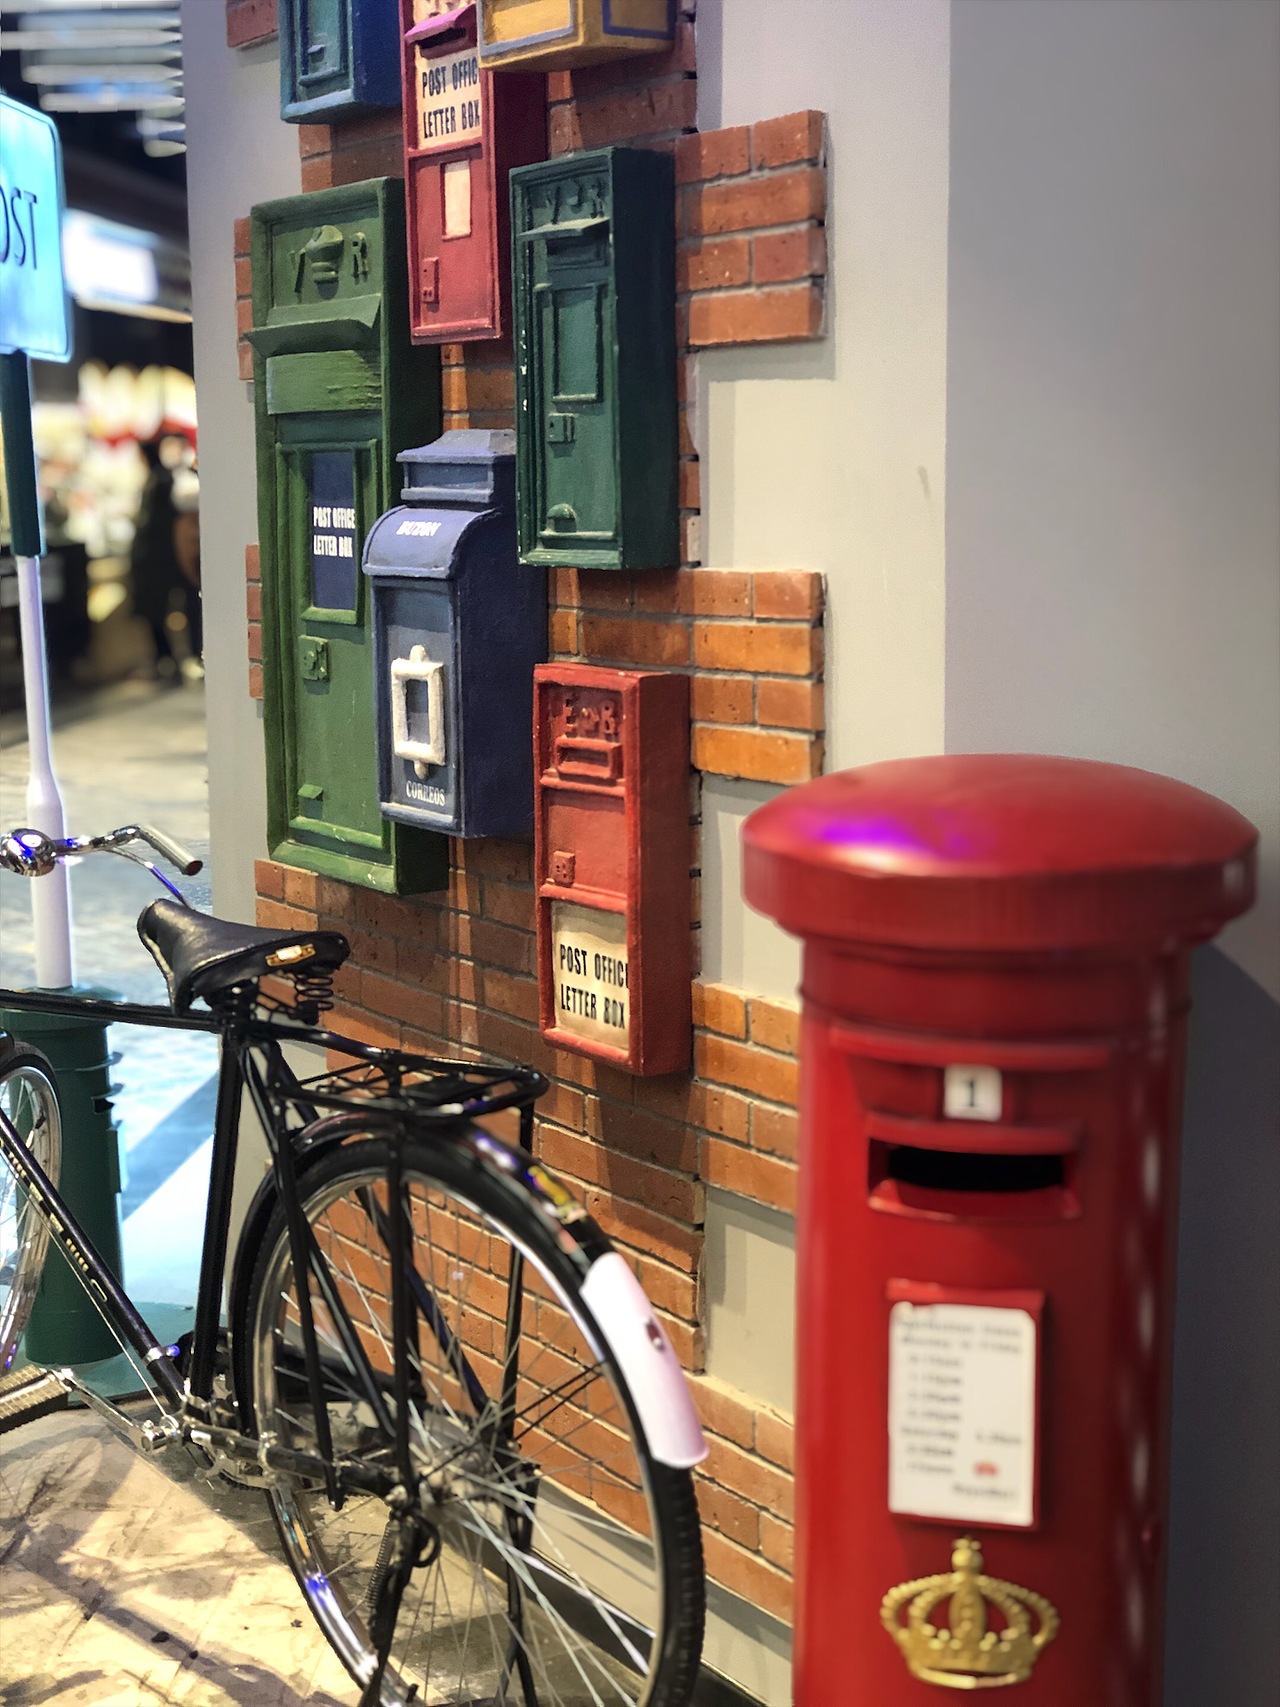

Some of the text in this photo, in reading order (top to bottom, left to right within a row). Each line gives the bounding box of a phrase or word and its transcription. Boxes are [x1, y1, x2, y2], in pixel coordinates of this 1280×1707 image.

[421, 57, 478, 98] POST OFFIC
[423, 99, 481, 139] LETTER BOX
[313, 506, 355, 529] POST OFFICE
[313, 534, 338, 557] LETTER
[406, 780, 446, 807] CORREOS
[560, 943, 587, 977] POST
[560, 983, 625, 1030] LETTER BOX
[962, 1078, 981, 1109] 1
